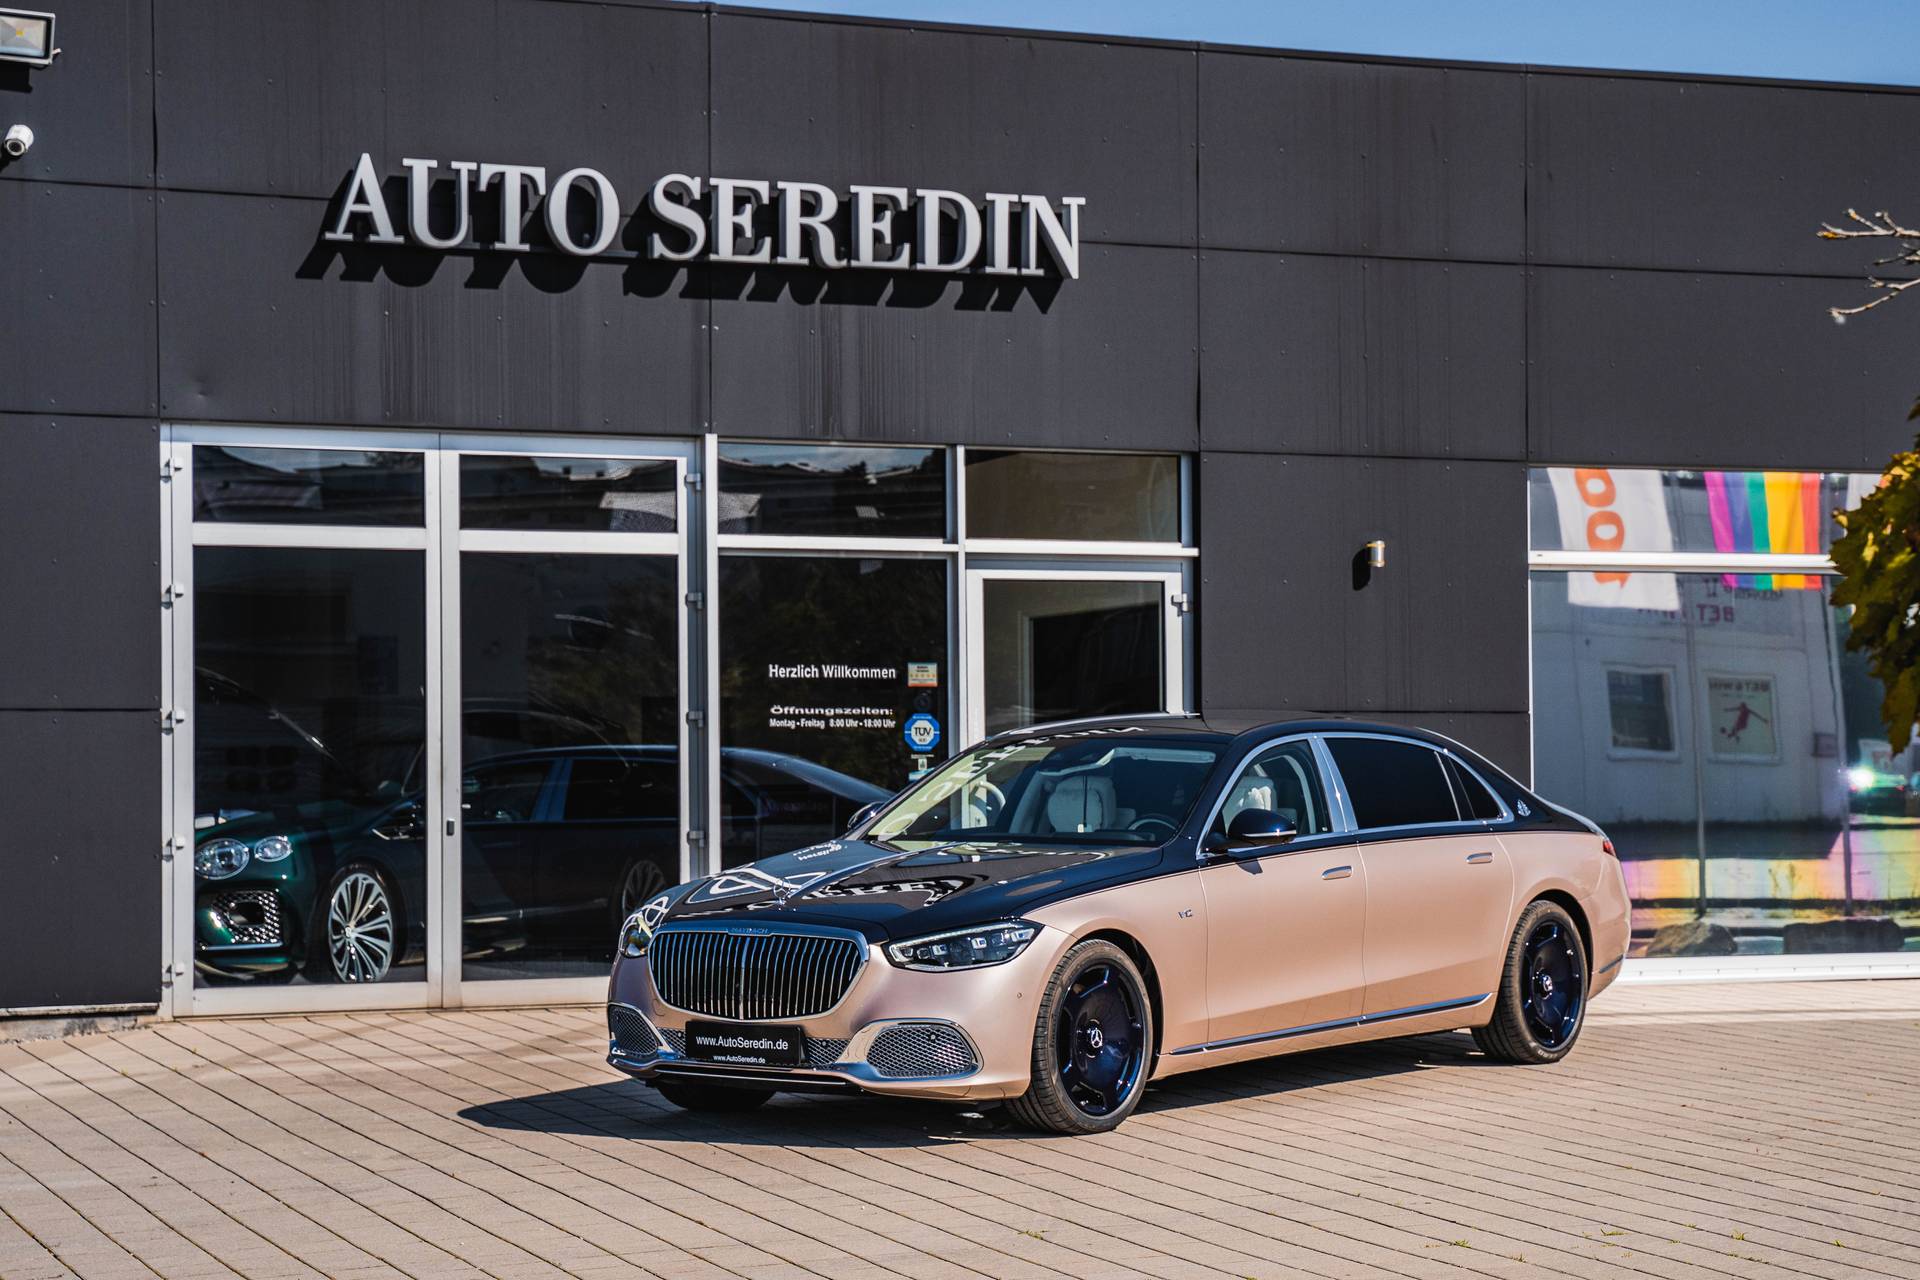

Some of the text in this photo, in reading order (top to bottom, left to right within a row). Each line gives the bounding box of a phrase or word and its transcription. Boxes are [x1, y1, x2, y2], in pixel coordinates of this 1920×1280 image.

[324, 152, 1087, 280] AUTO SEREDIN
[768, 664, 820, 678] Herzlich
[822, 664, 897, 679] Willkommen
[769, 704, 894, 716] Öffnungszeiten:
[769, 718, 796, 729] Montag
[800, 718, 826, 730] Freitag
[829, 718, 845, 728] 8:00
[845, 718, 859, 728] Uhr
[864, 718, 881, 729] 18:00
[883, 719, 896, 729] Uhr
[695, 1035, 789, 1050] www.AutoSeredin.de
[712, 1054, 766, 1064] www.AutoSeredin.de
